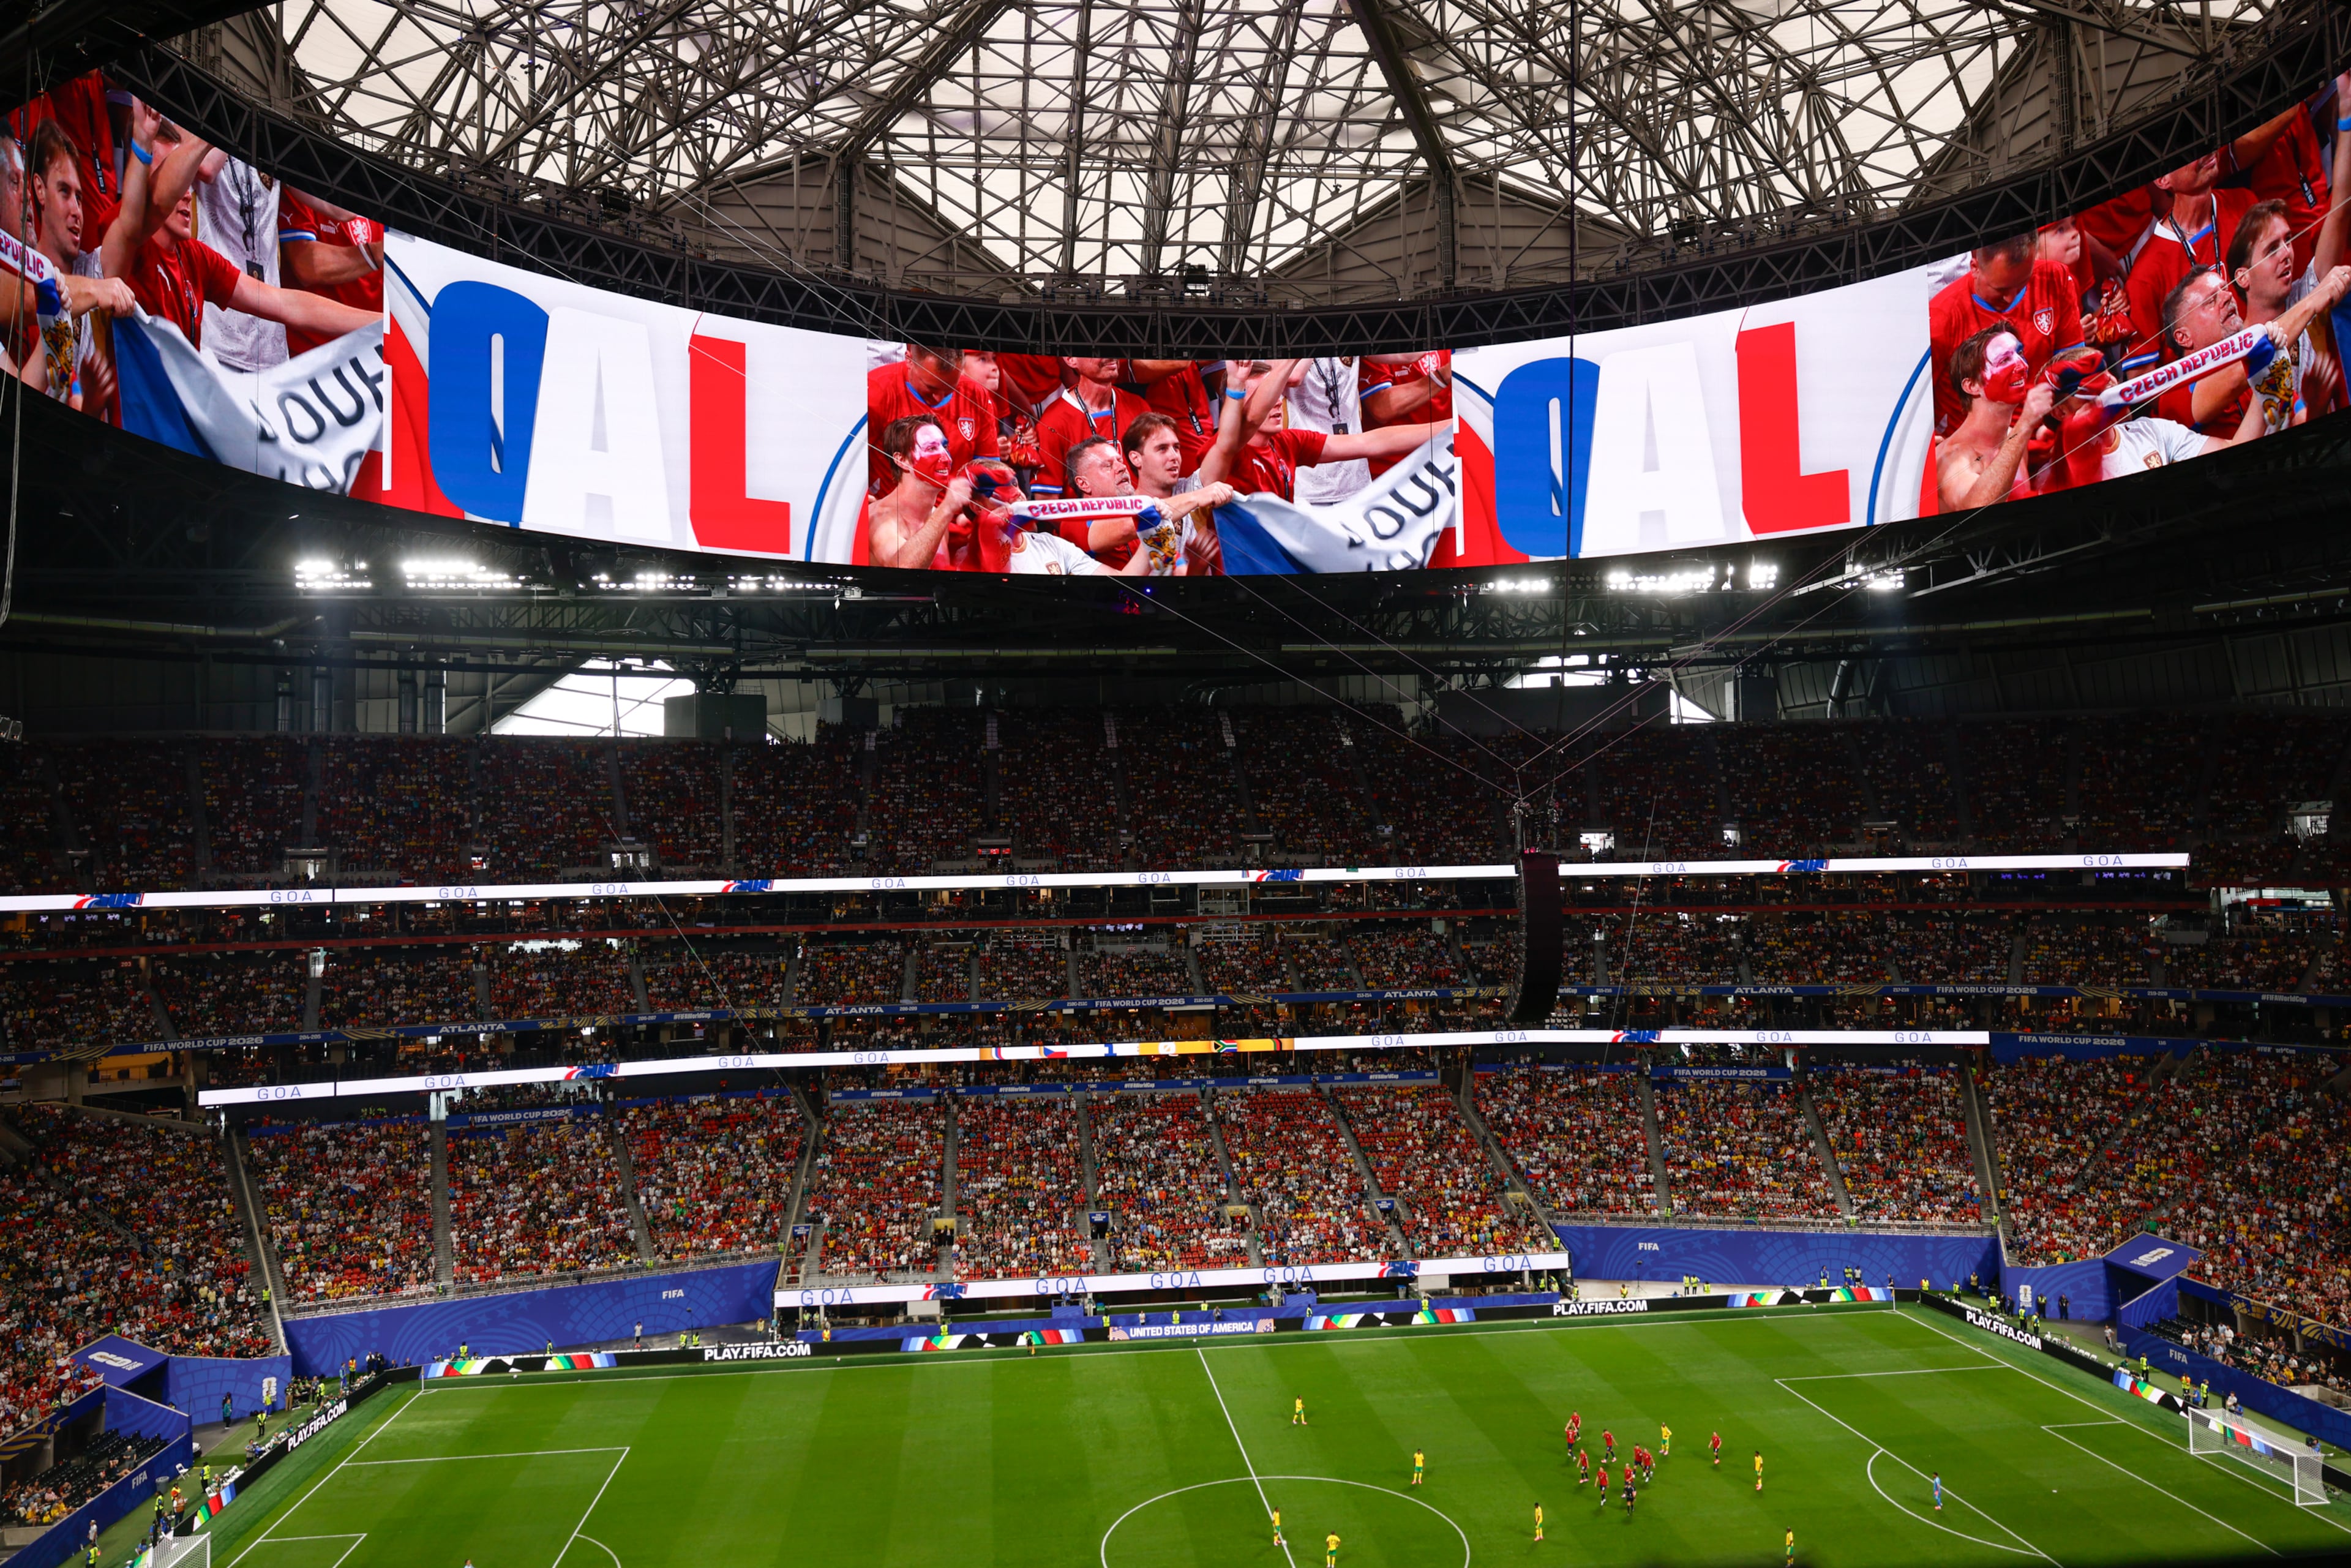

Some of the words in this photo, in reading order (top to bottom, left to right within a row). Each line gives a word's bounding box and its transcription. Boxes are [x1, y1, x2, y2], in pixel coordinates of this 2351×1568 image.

[2120, 366, 2178, 402] CZECH
[2180, 332, 2254, 375] REPUBLIC
[384, 280, 790, 554] OAL
[1455, 321, 1850, 557] OAL
[1028, 501, 1078, 517] CZECH
[1080, 499, 1142, 511] REPUBLIC
[1932, 858, 1967, 868] GOA
[2083, 855, 2122, 866] GOA
[1395, 868, 1426, 877] GOA
[1653, 863, 1686, 872] GOA
[872, 878, 905, 888] GOA
[1007, 876, 1039, 885] GOA
[1138, 873, 1171, 882] GOA
[439, 888, 477, 898] GOA
[593, 884, 628, 895] GOA
[271, 891, 312, 902] GOA
[2261, 994, 2307, 1003] #FIFAWorldCup
[439, 1024, 506, 1033] ATLANTA
[1371, 1036, 1404, 1046] GOA
[1495, 1032, 1527, 1042] GOA
[1757, 1032, 1792, 1041] GOA
[1895, 1032, 1932, 1042] GOA
[144, 1043, 165, 1052] FIFA
[168, 1040, 204, 1050] WORLD
[206, 1038, 227, 1047] CUP
[228, 1037, 264, 1045] 2026
[1104, 1044, 1117, 1057] 1
[719, 1056, 754, 1067] GOA
[854, 1052, 889, 1063] GOA
[425, 1075, 465, 1088] GOA
[258, 1086, 301, 1100] GOA
[1484, 1255, 1531, 1272] GOA
[1151, 1272, 1201, 1289] GOA
[1264, 1266, 1313, 1283] GOA
[1036, 1277, 1087, 1294] GOA
[662, 1289, 684, 1299] FIFA
[801, 1288, 853, 1305] GOA
[1553, 1300, 1648, 1316] PLAY.FIFA.COM
[1130, 1327, 1163, 1337] UNITED
[1164, 1324, 1198, 1335] STATES
[1199, 1324, 1210, 1334] OF
[1212, 1322, 1254, 1333] AMERICA
[1966, 1310, 2042, 1350] PLAY.FIFA.COM
[705, 1343, 811, 1360] PLAY.FIFA.COM
[2169, 1349, 2188, 1365] FIFA
[288, 1399, 347, 1452] PLAY.FIFA.COM
[132, 1471, 148, 1489] FIFA
